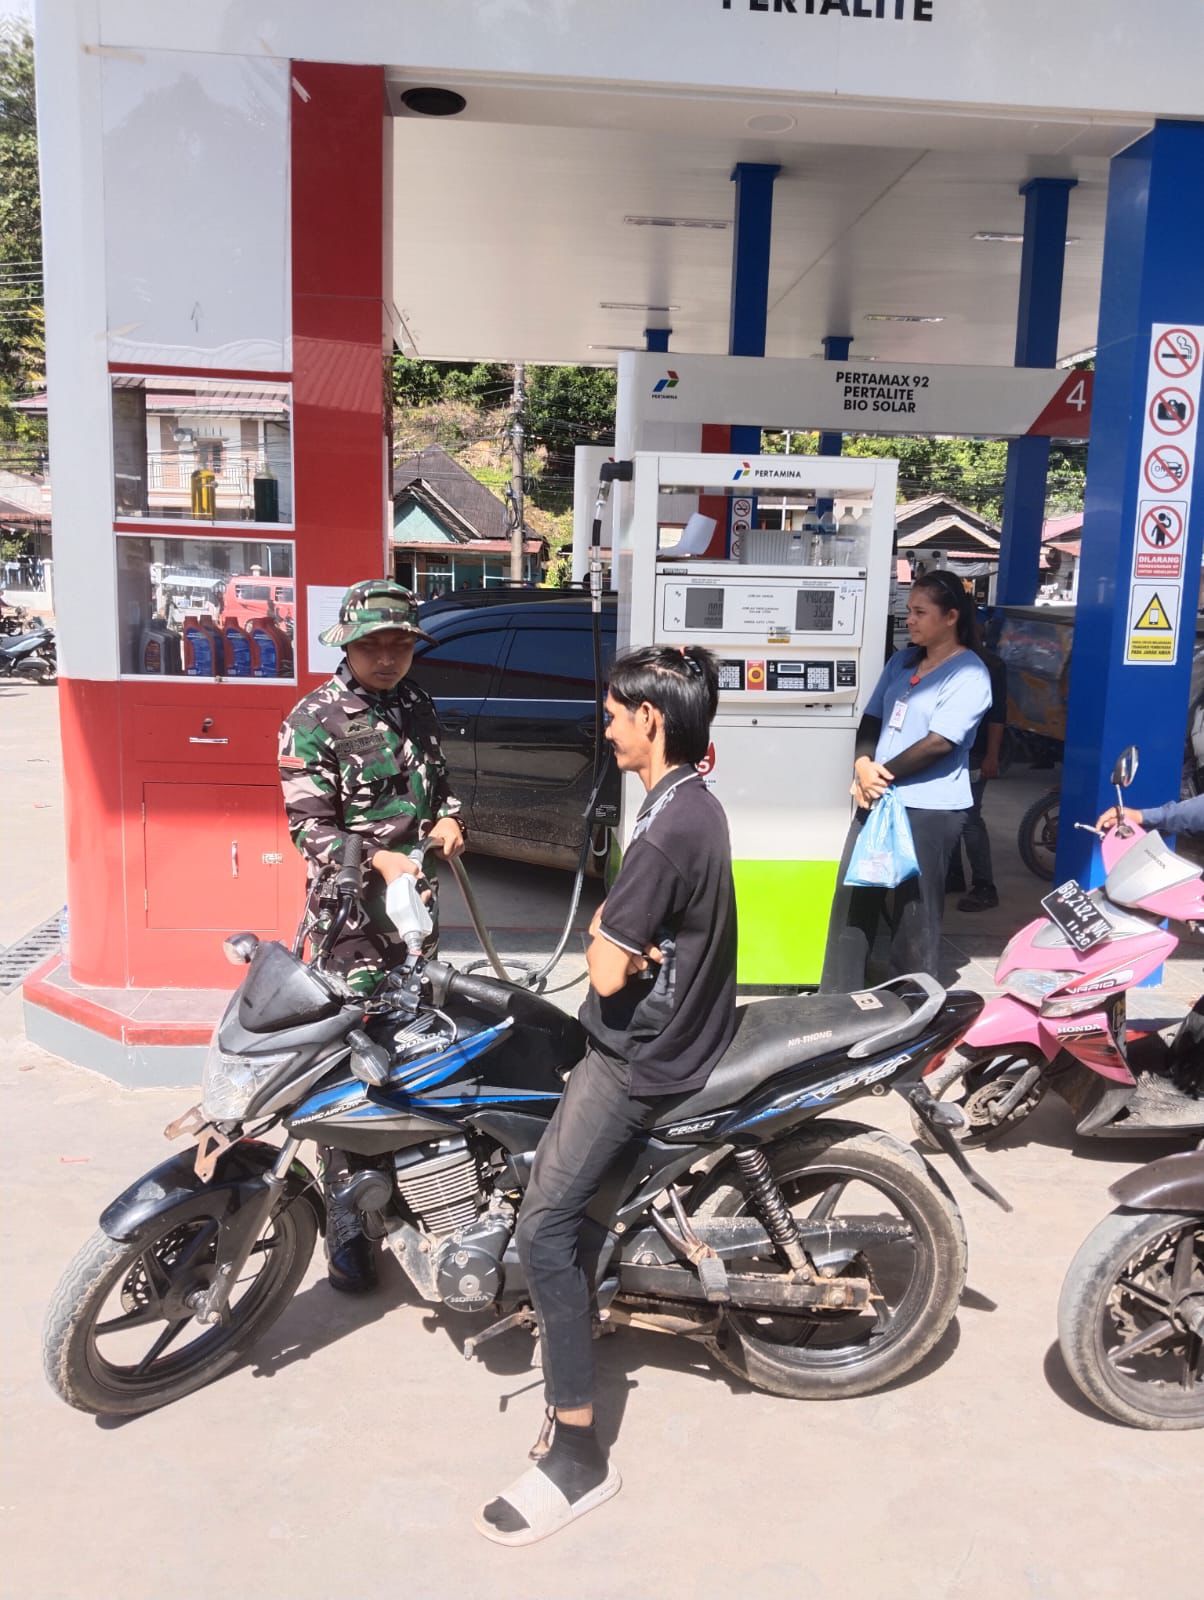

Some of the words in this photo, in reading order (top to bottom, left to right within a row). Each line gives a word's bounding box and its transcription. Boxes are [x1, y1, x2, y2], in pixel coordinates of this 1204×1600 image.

[835, 371, 910, 387] PERTAMAX
[912, 376, 930, 388] 92
[843, 385, 914, 401] PERTALITE
[1066, 379, 1086, 412] 4
[843, 399, 868, 411] BIO
[872, 400, 916, 413] SOLAR
[754, 469, 802, 479] PERTAMINA
[1138, 556, 1180, 564] DILARANG
[1088, 919, 1111, 939] NK
[1065, 980, 1115, 994] VARIO
[1057, 1023, 1103, 1034] HONDA
